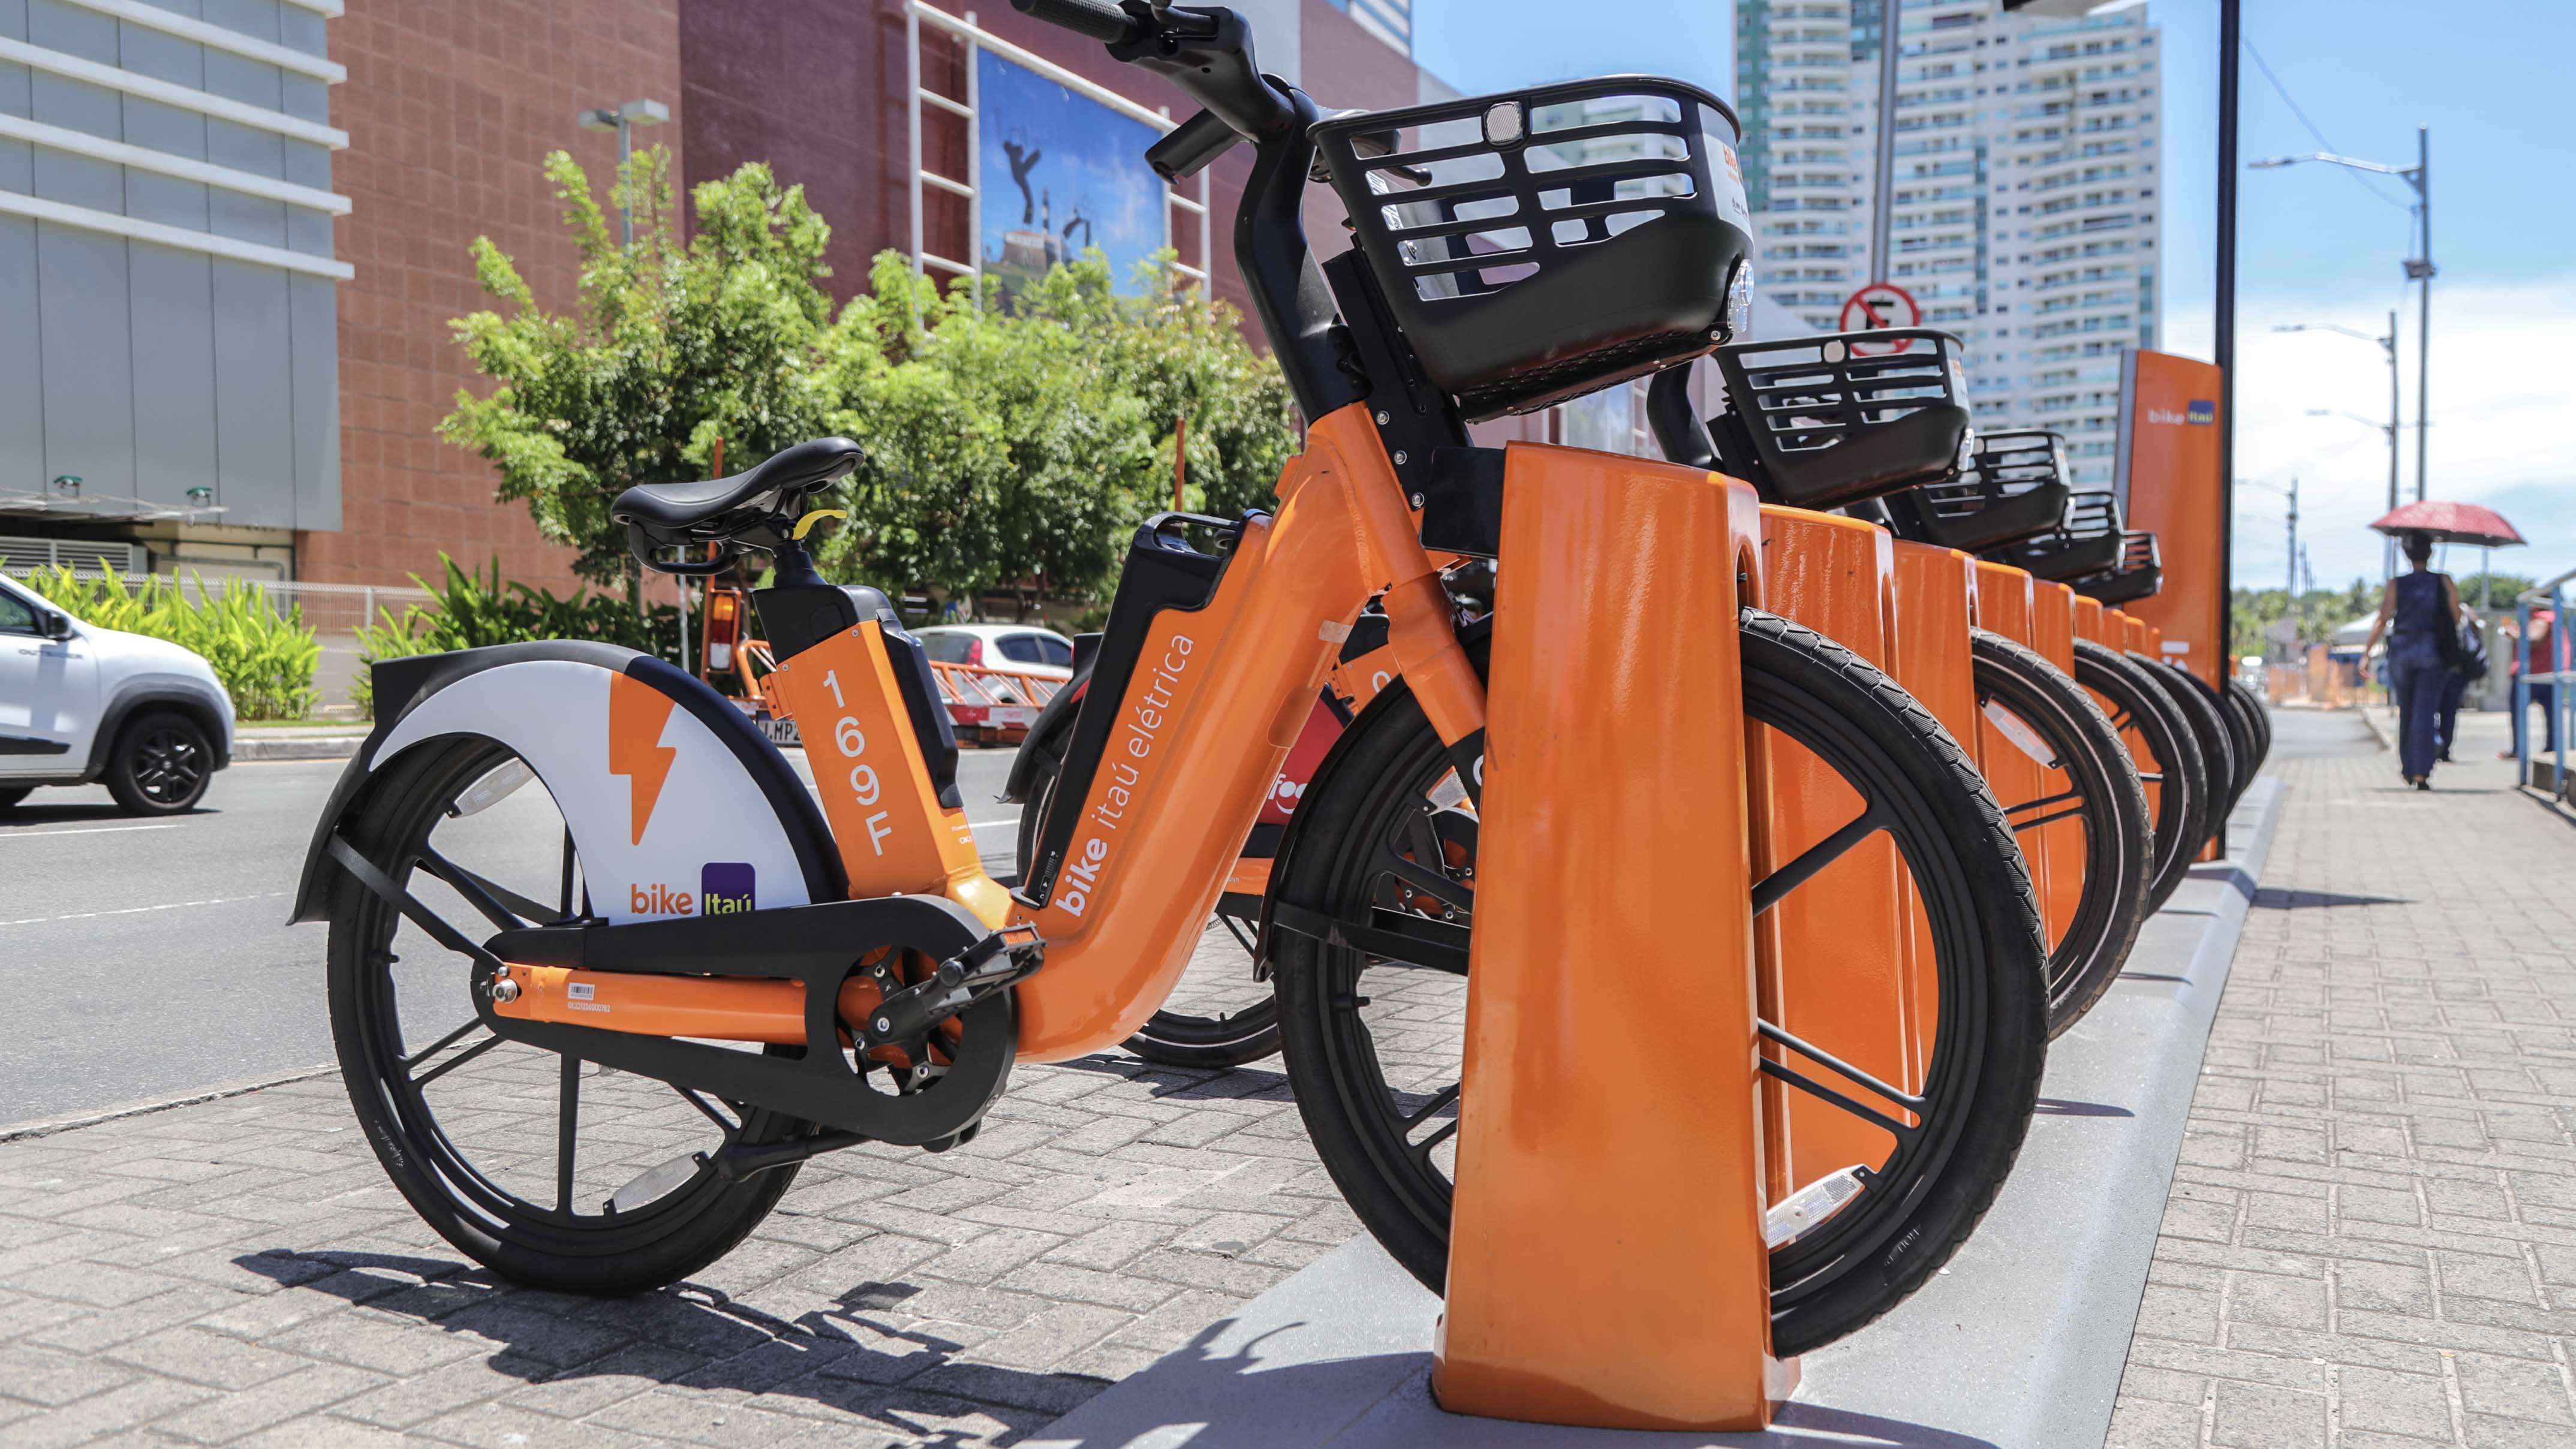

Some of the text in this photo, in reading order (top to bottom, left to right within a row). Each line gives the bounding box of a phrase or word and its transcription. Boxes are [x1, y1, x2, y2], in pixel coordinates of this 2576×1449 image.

[2148, 408, 2185, 424] bike
[1055, 635, 1194, 917] bike itaú elétrica
[631, 883, 752, 915] bike Itaú
